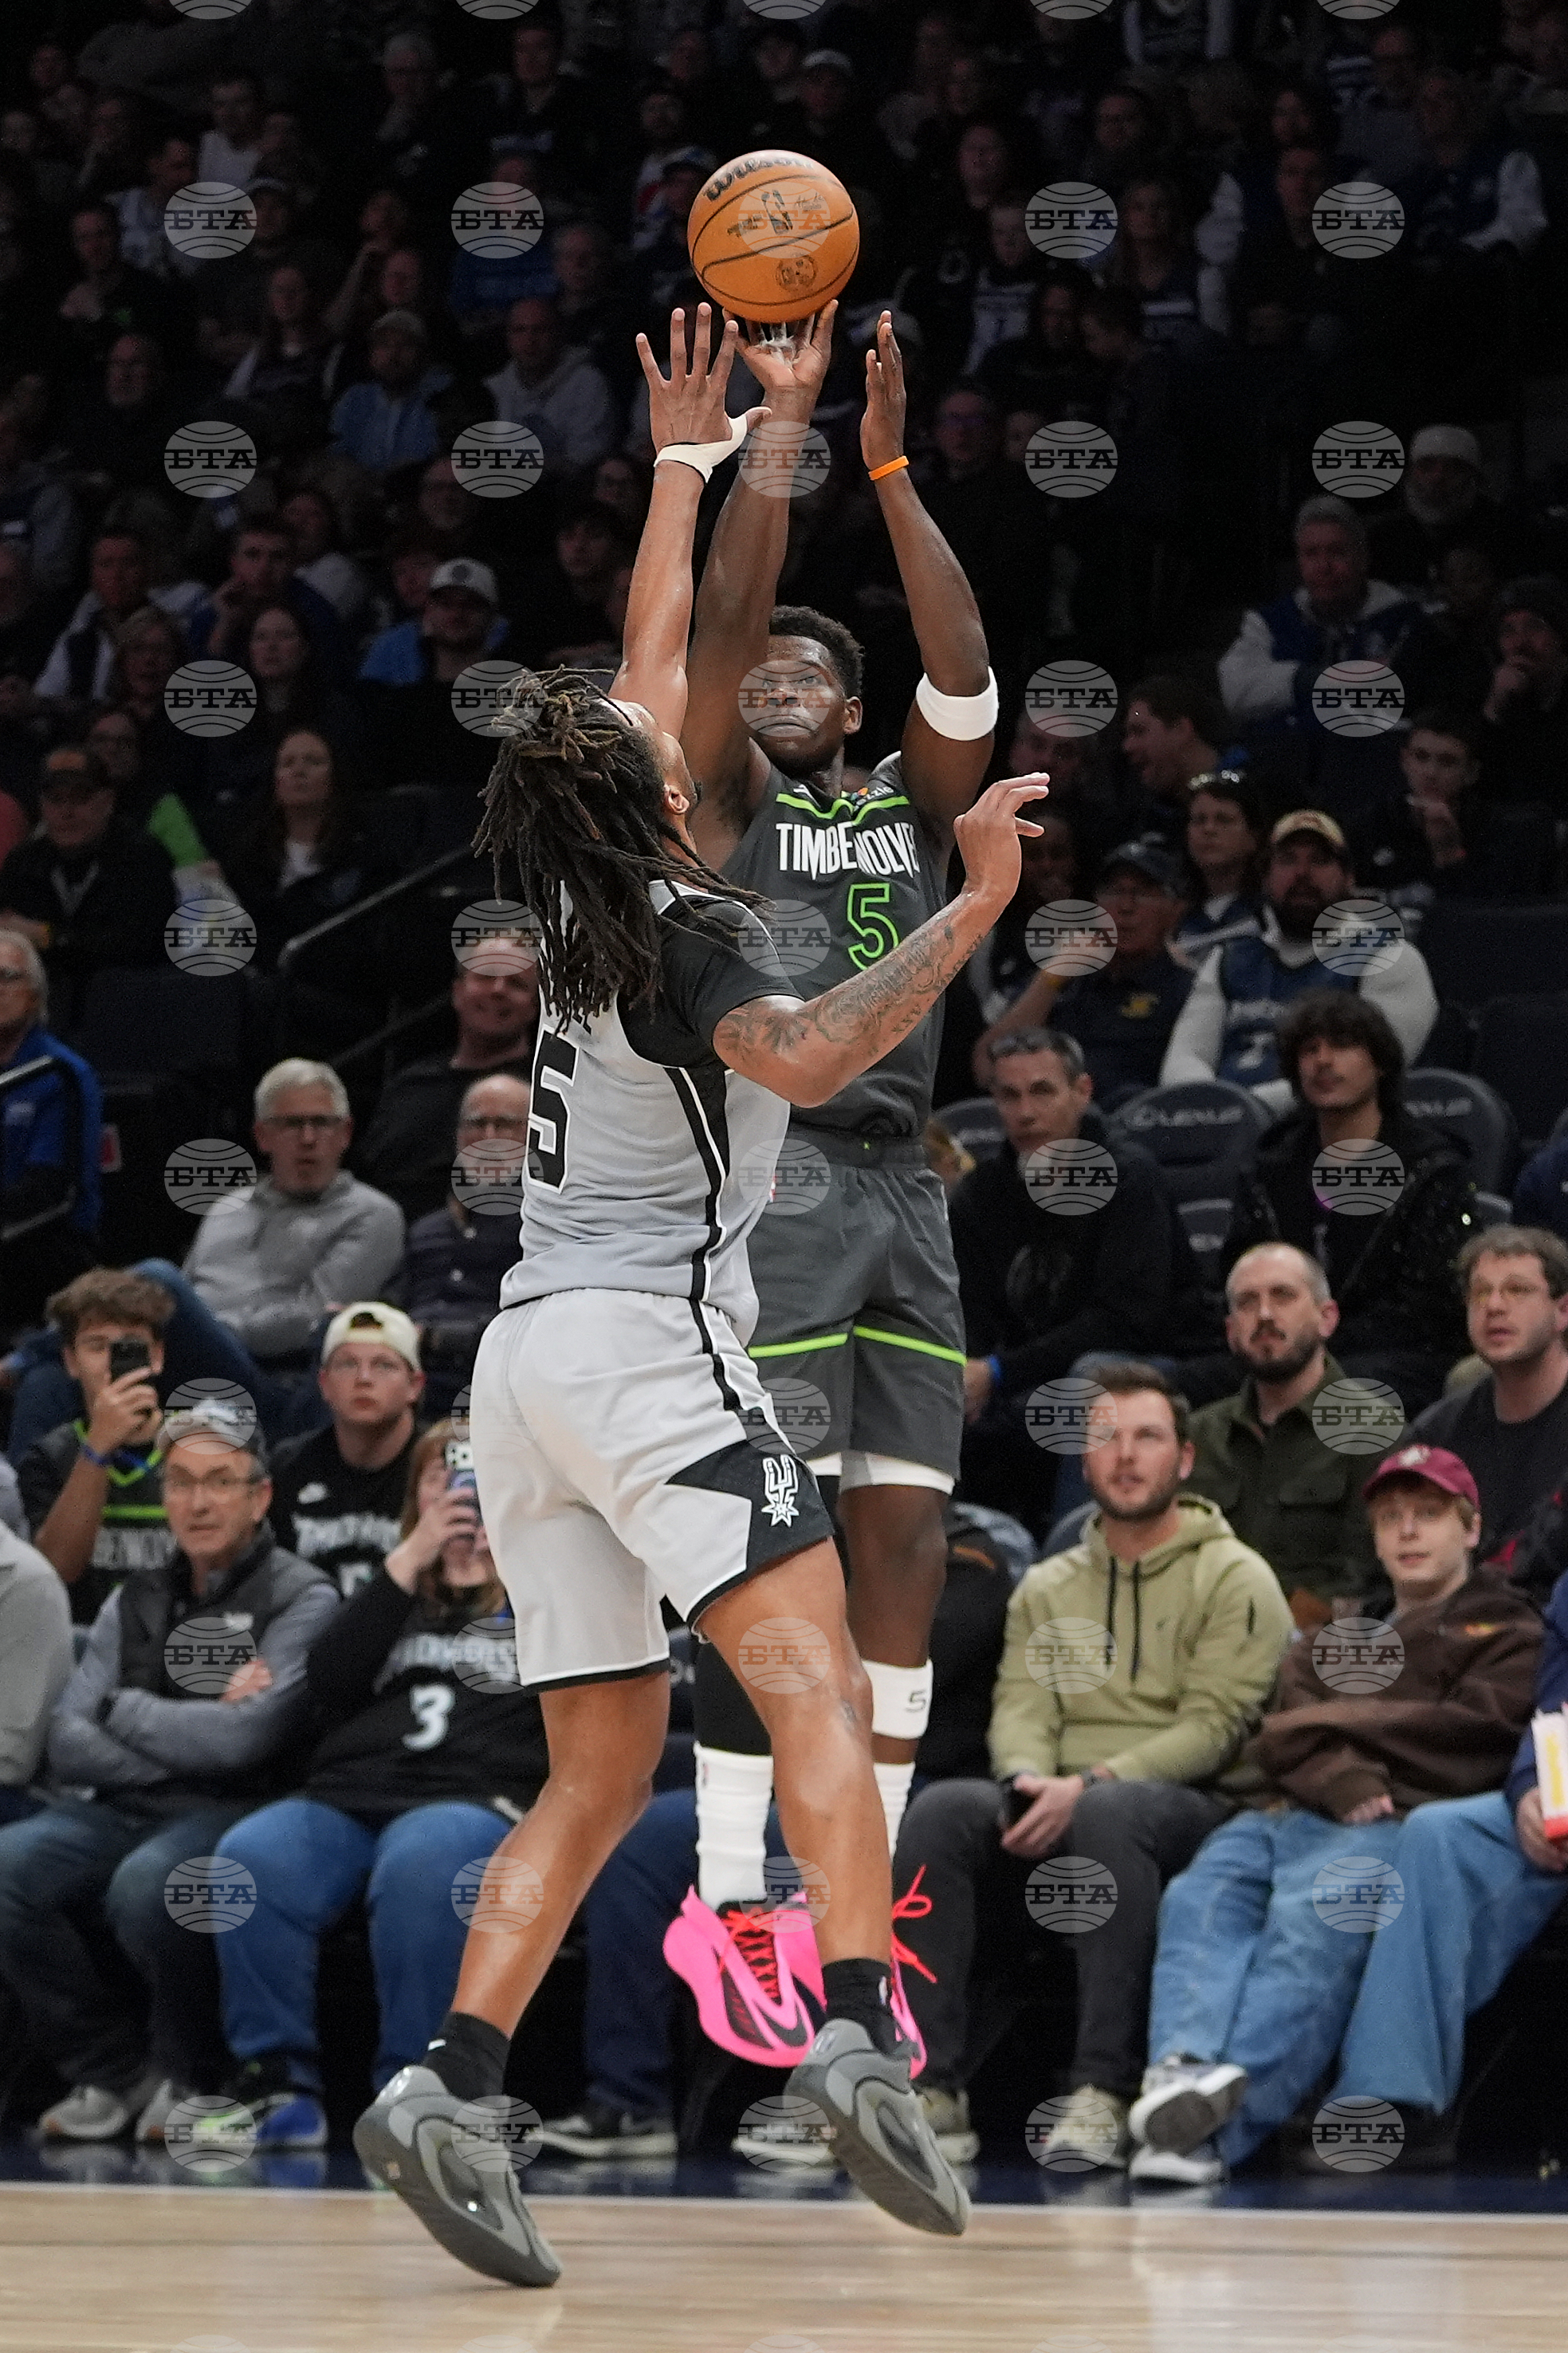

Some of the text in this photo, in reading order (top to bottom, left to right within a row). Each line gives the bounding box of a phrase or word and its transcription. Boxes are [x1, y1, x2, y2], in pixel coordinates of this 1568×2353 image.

[847, 882, 901, 970] 5
[526, 1024, 580, 1194] 5
[402, 1682, 455, 1751] 3
[906, 1690, 926, 1713] 5
